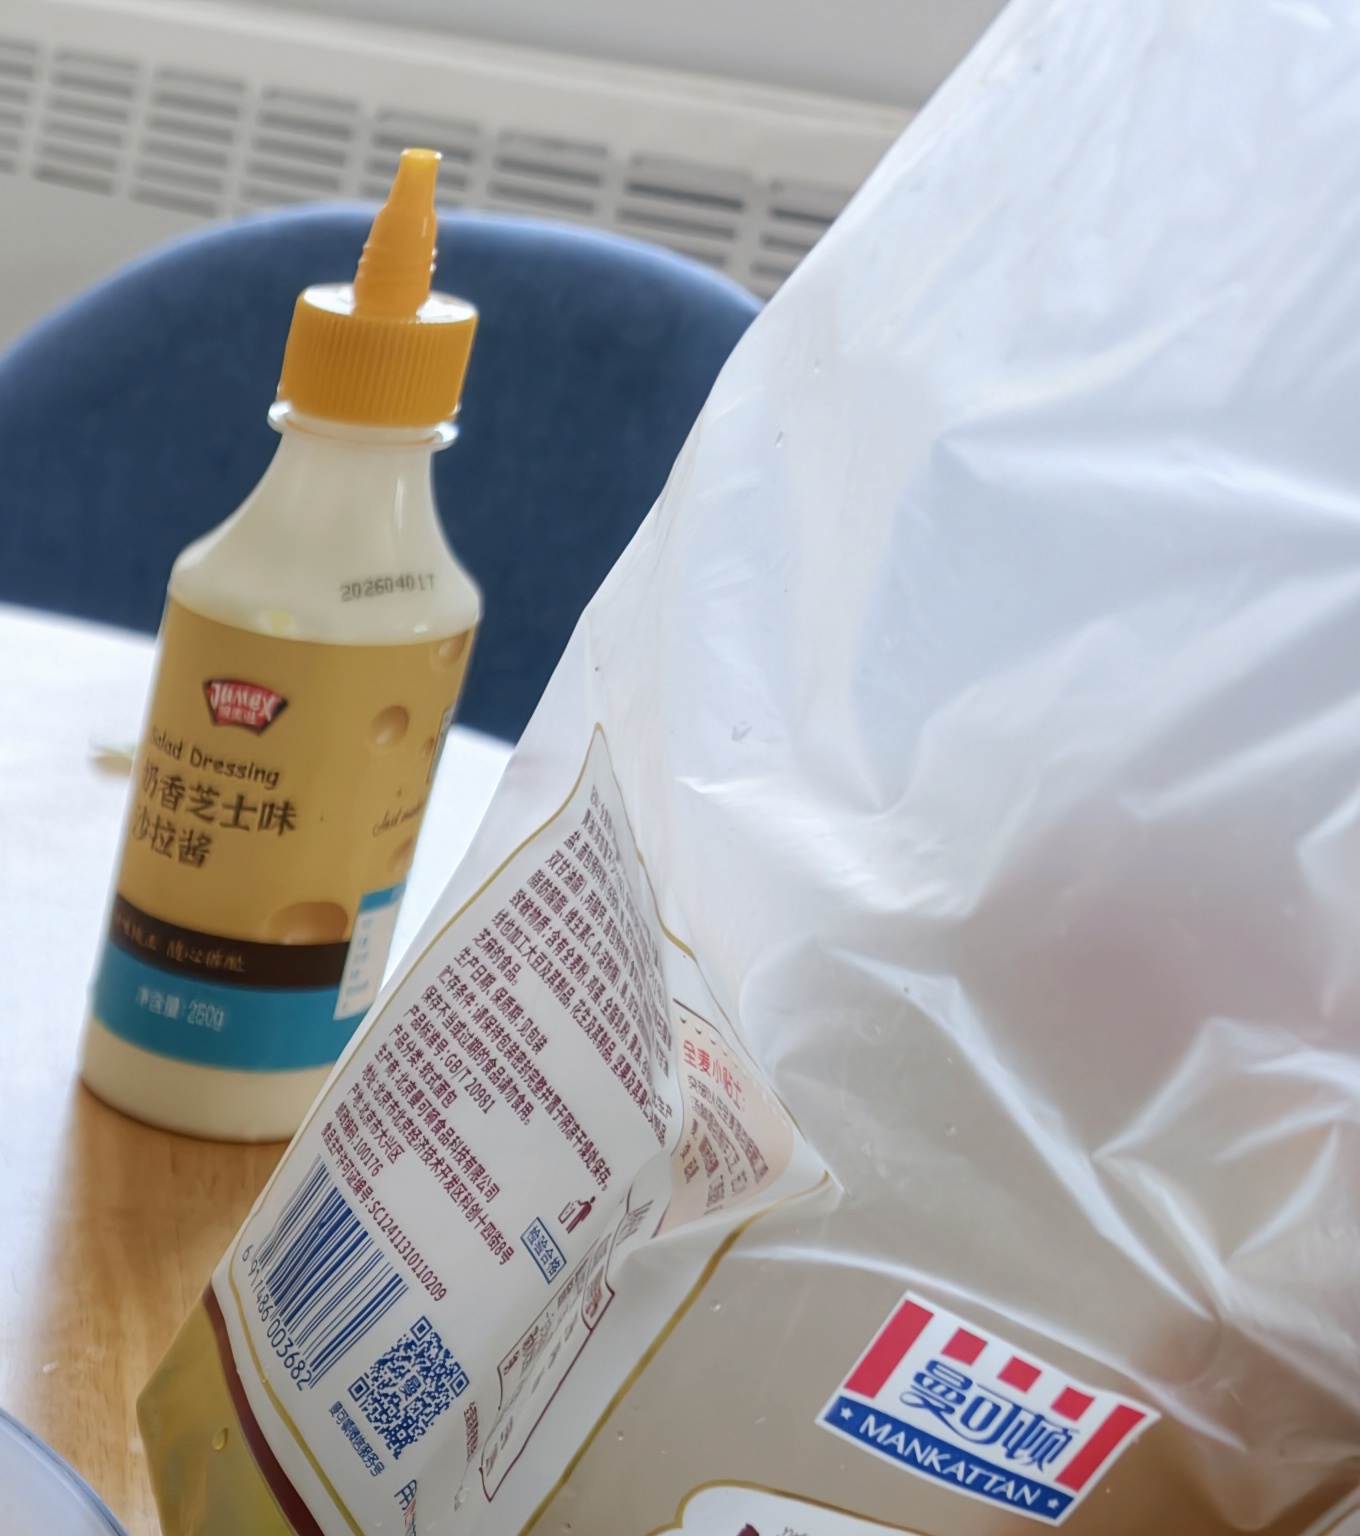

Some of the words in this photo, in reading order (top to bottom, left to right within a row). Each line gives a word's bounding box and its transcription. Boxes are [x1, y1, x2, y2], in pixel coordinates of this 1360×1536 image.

[143, 757, 298, 837] 奶香芝士味
[189, 744, 280, 791] Dressing
[133, 803, 212, 869] 沙拉酱
[266, 1317, 313, 1392] 003682
[899, 1357, 1083, 1475] 曼可顿
[857, 1410, 1043, 1507] MANKATTAN
